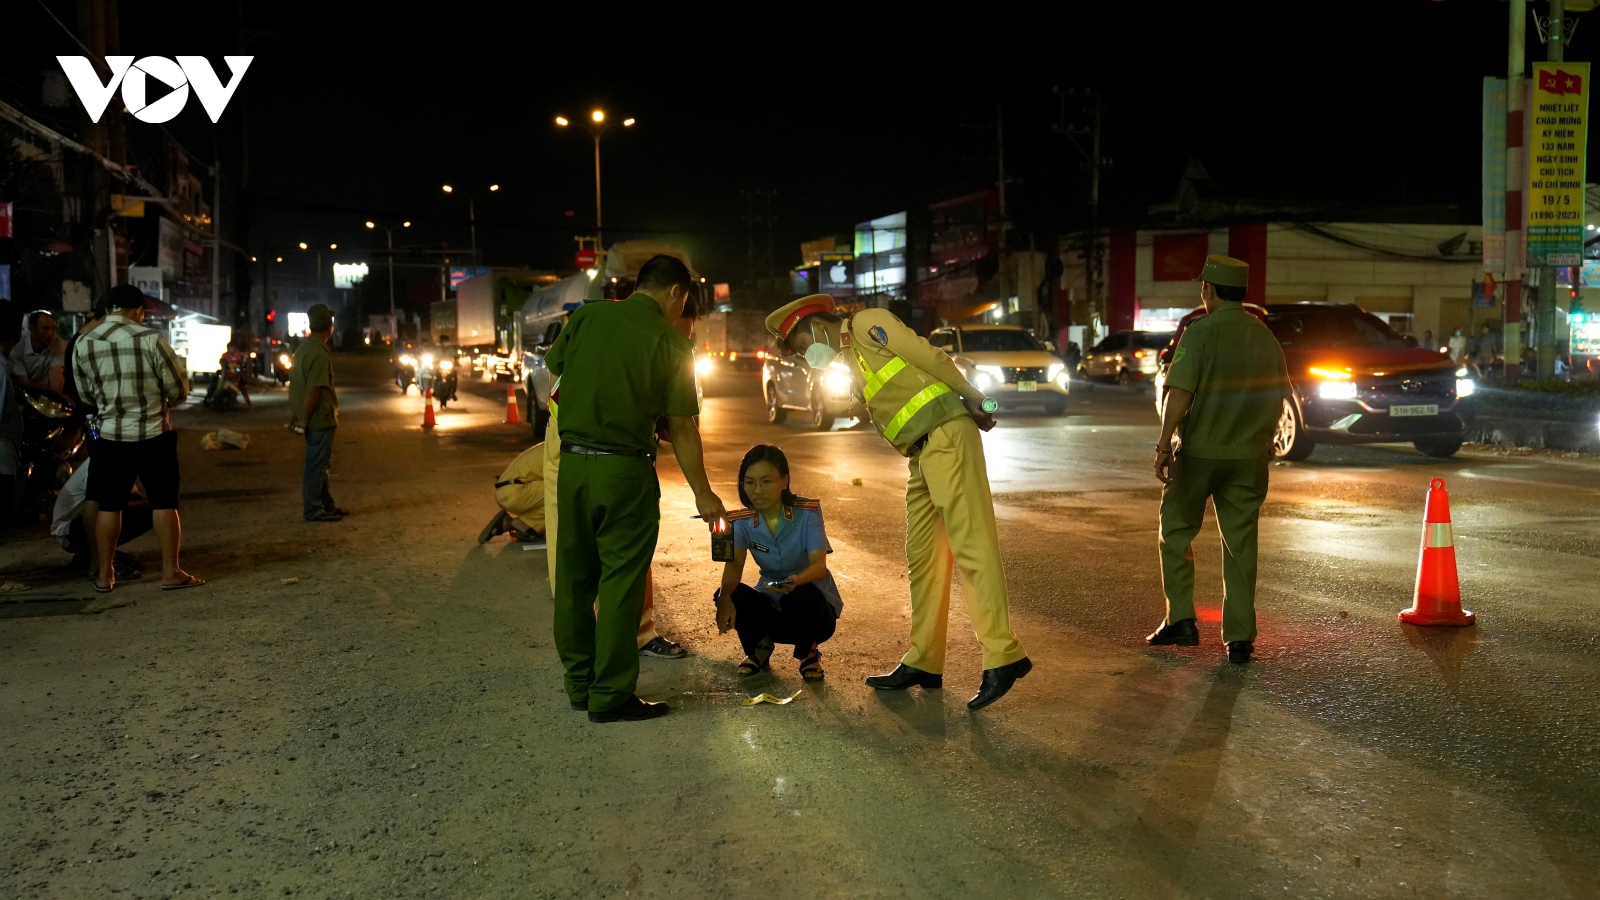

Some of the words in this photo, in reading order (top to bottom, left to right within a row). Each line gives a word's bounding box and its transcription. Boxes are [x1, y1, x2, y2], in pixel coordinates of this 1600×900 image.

[1539, 104, 1561, 113] NHIỆT
[1563, 104, 1579, 113] LIỆT
[1536, 116, 1556, 125] CHÀO
[1559, 116, 1581, 125] MỪNG
[1554, 129, 1574, 139] NIỆM
[1542, 143, 1554, 151] 133
[1557, 142, 1575, 151] NĂM
[1536, 155, 1557, 163] NGÀY
[1539, 167, 1555, 176] CHỦ
[1557, 168, 1574, 178] TỊCH
[1532, 179, 1543, 189] HỒ
[1545, 179, 1558, 189] CHÍ
[1560, 181, 1581, 189] MINH
[1543, 195, 1554, 205] 19
[1564, 195, 1570, 205] 5
[1530, 211, 1580, 220] (1890-2023)
